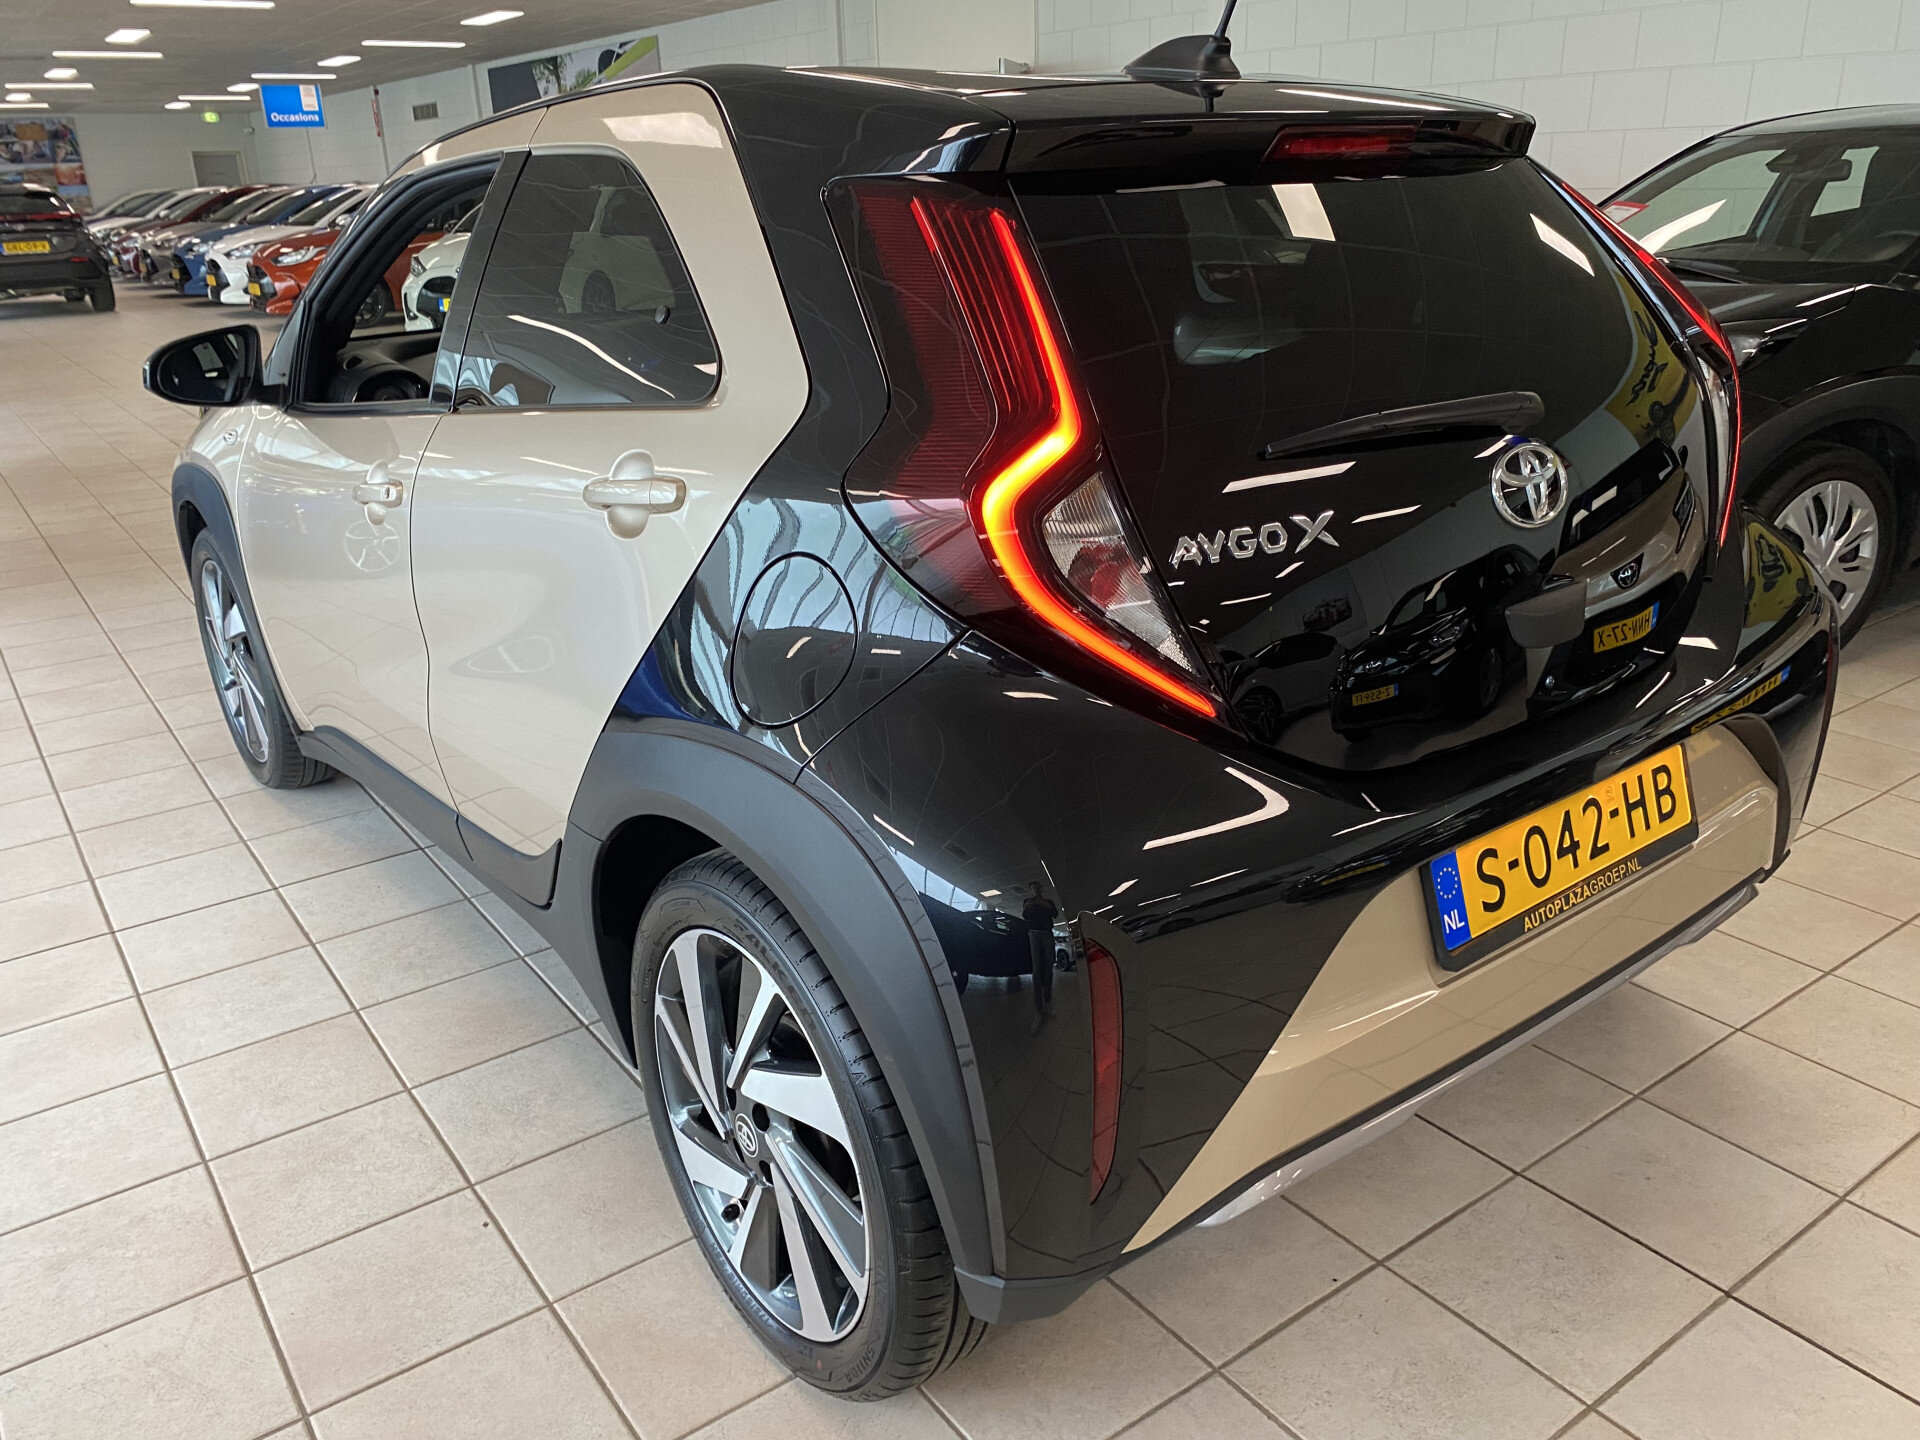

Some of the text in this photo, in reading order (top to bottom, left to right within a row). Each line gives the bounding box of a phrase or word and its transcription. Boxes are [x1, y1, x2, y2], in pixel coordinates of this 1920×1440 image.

[270, 111, 320, 123] Occasions
[1168, 508, 1341, 570] AYGO X
[1474, 763, 1678, 914] S-042-HB
[1443, 908, 1466, 934] NL
[1523, 857, 1643, 933] AUTOPLAZAGROEP.NL
